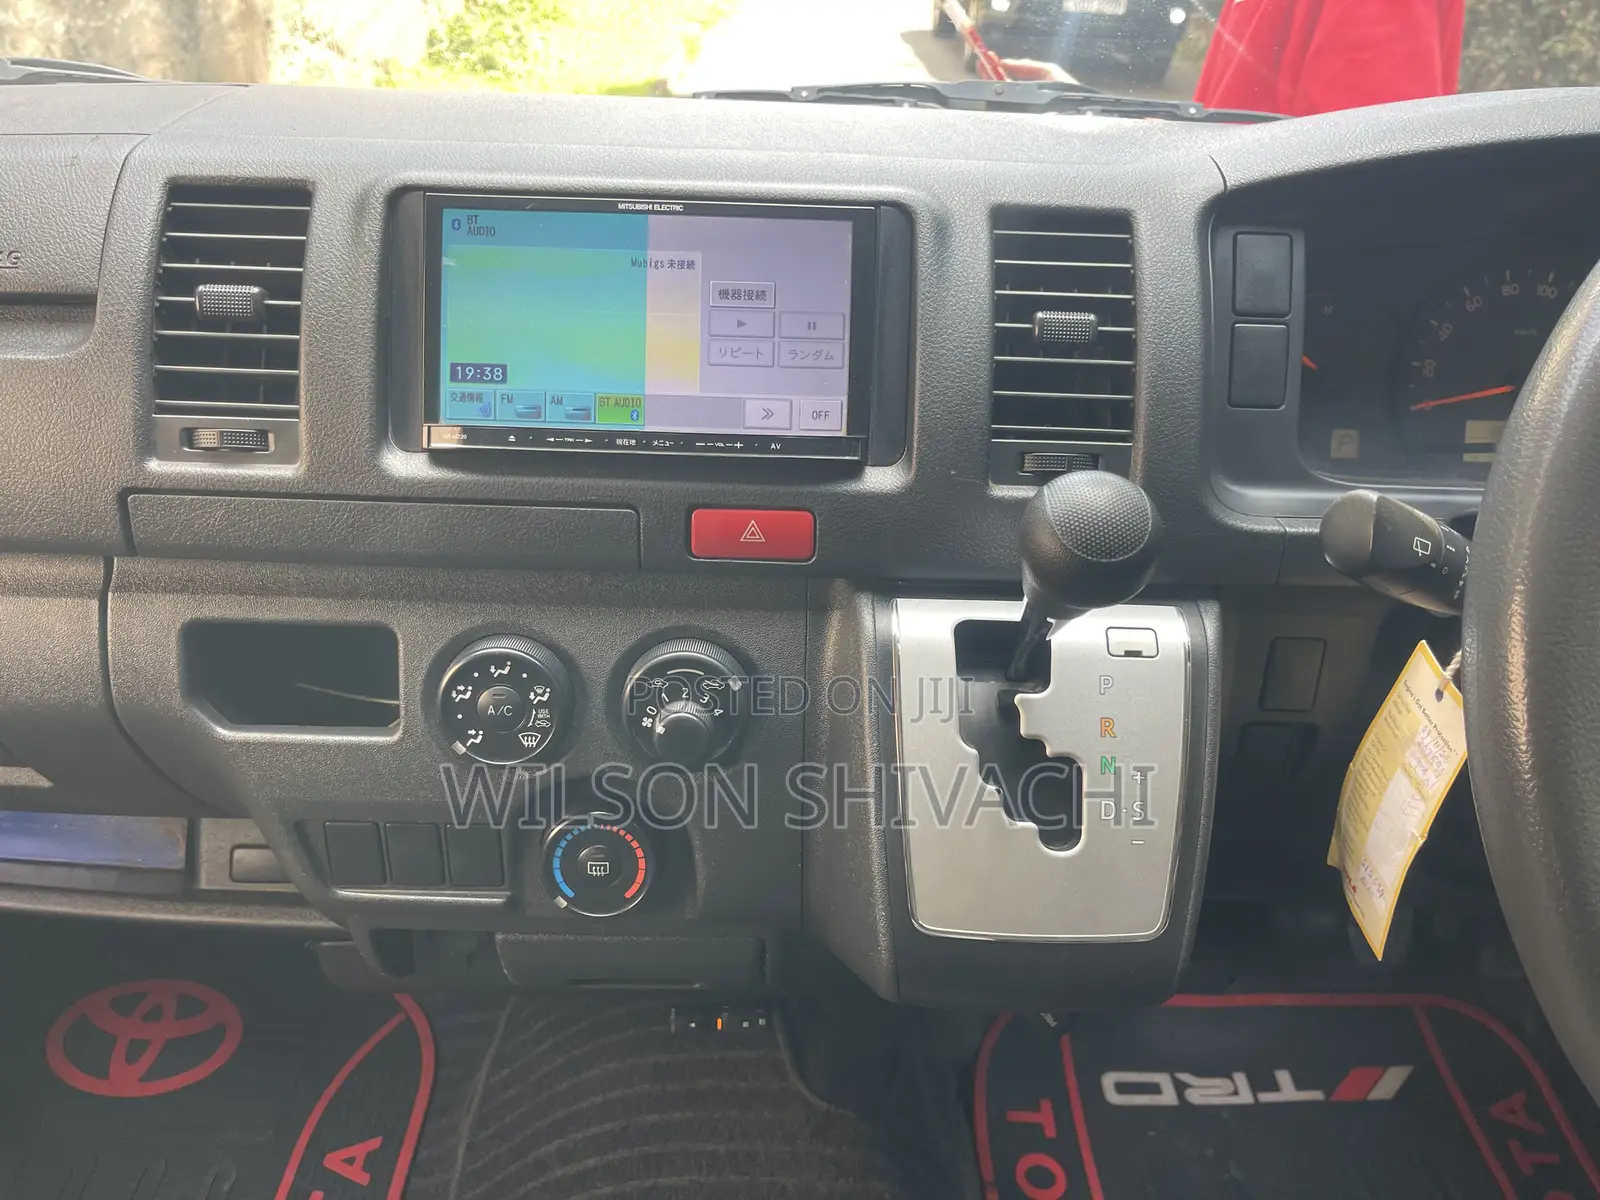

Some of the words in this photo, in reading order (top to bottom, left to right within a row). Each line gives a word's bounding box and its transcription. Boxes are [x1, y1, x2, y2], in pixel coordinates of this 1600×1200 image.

[618, 203, 652, 211] MITSUBISHI
[653, 204, 684, 212] ELECTRIC
[467, 214, 479, 225] BT
[467, 225, 496, 237] AUDIO
[667, 259, 696, 271] 未接続
[718, 288, 768, 302] 機器接続
[1501, 283, 1520, 297] 80
[1536, 283, 1558, 299] 100
[1465, 295, 1483, 312] 60
[1438, 322, 1454, 342] 40
[719, 346, 764, 360] リピート
[788, 349, 835, 362] ランダム
[456, 366, 503, 382] 19:38
[501, 393, 514, 405] FM
[550, 396, 563, 406] AM
[599, 396, 611, 407] BT
[614, 397, 642, 408] AUDIO
[812, 410, 830, 421] OFF
[1099, 675, 1115, 695] P
[661, 692, 669, 702] 1
[681, 687, 689, 698] 2
[699, 692, 710, 703] 3
[487, 704, 513, 717] A/C
[713, 708, 724, 716] 4
[1100, 718, 1116, 738] R
[1100, 756, 1116, 775] N
[1100, 1070, 1326, 1106] TRD
[1488, 1088, 1578, 1200] TA
